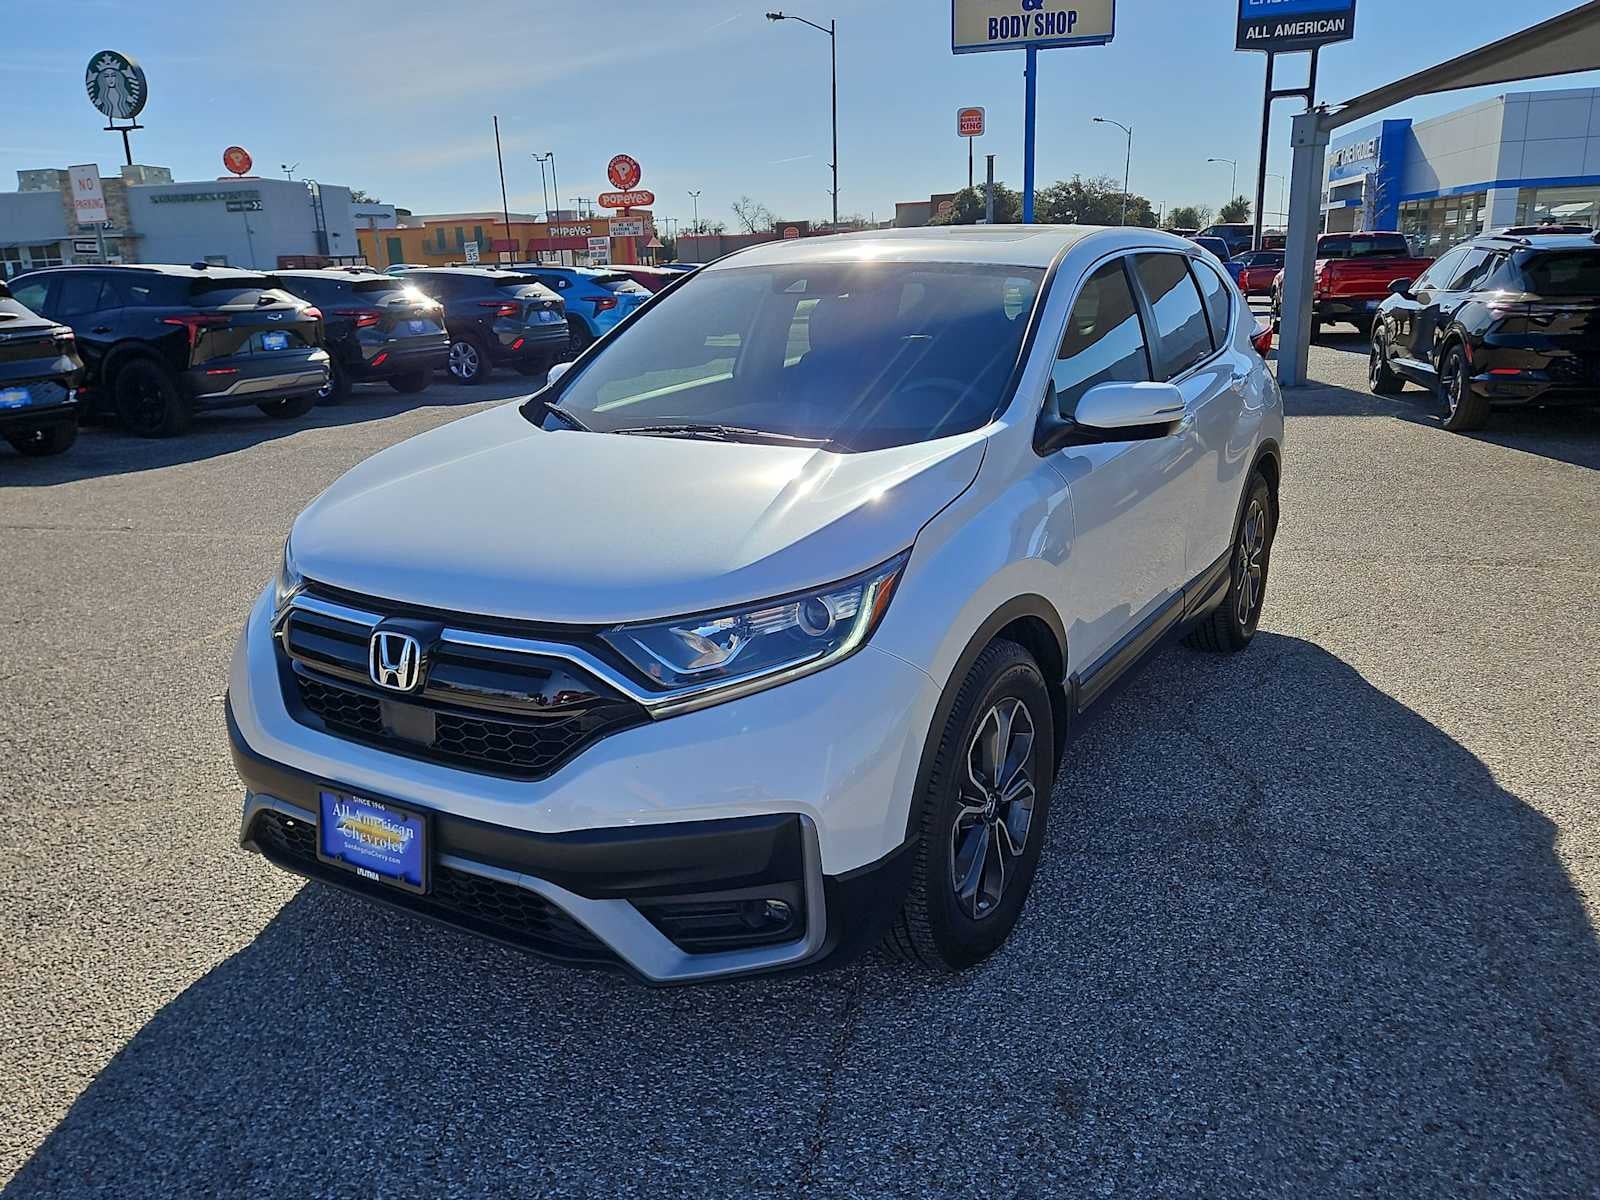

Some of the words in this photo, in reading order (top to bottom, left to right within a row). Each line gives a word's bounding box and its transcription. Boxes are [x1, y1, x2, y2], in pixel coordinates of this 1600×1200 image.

[988, 15, 1030, 40] BODY
[1035, 11, 1077, 36] SHOP
[1246, 25, 1270, 39] ALL
[1274, 19, 1345, 37] AMERICAN
[960, 122, 983, 131] KING
[79, 178, 94, 191] NO
[72, 198, 105, 209] PARKING
[467, 252, 478, 261] 35
[353, 796, 371, 807] SINCE
[332, 803, 350, 817] All
[354, 809, 414, 839] American
[343, 822, 403, 854] Chevrolet
